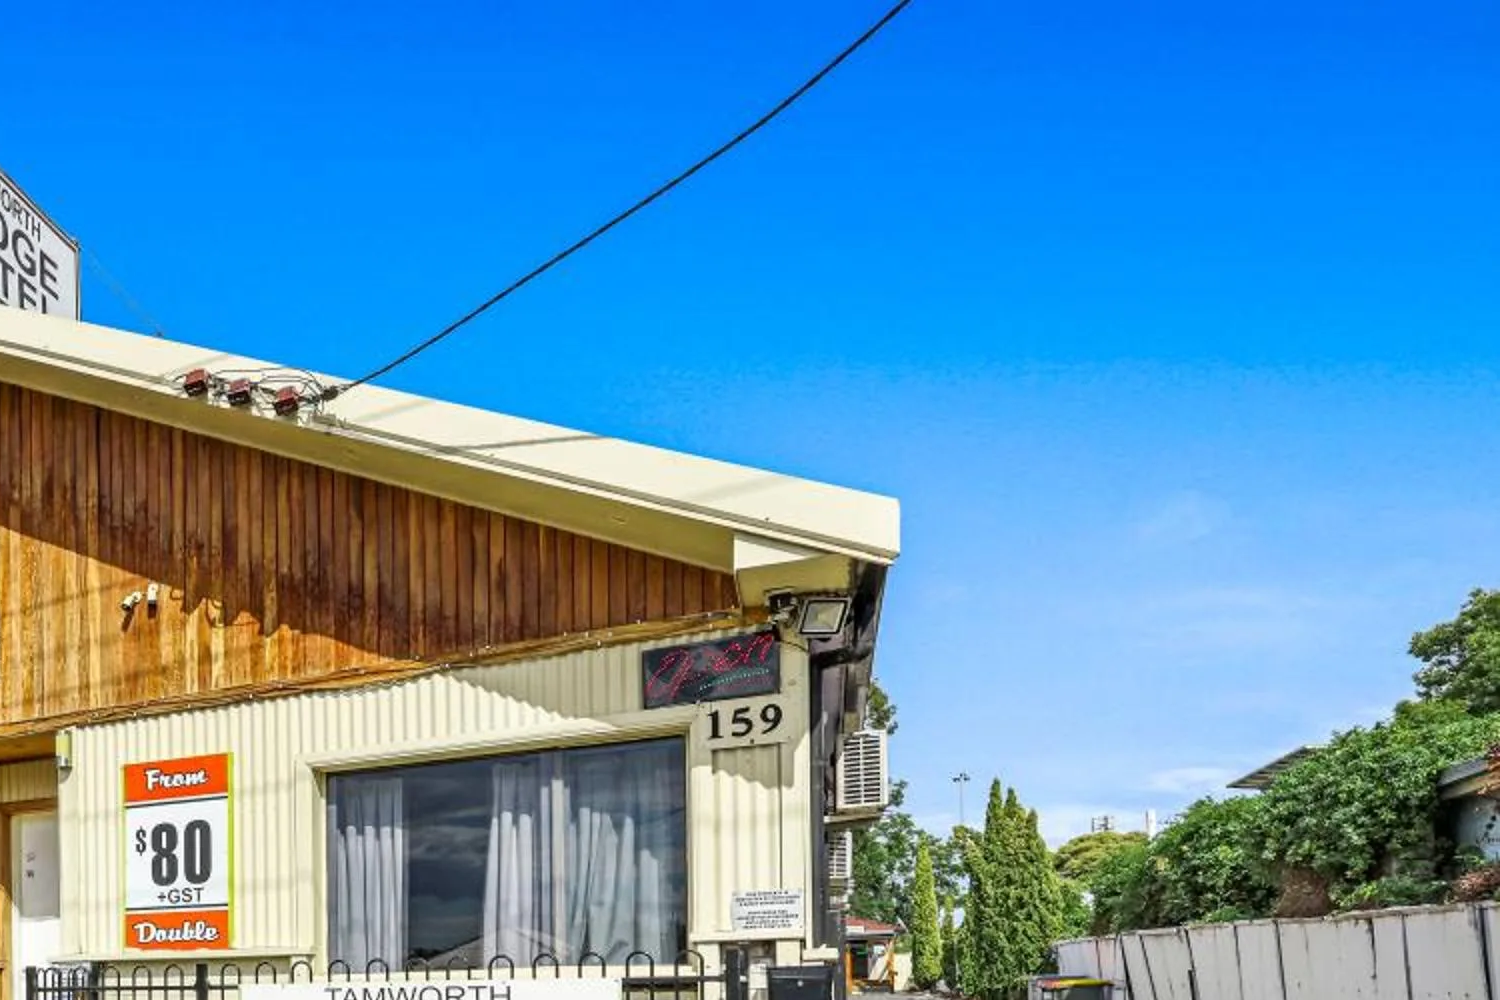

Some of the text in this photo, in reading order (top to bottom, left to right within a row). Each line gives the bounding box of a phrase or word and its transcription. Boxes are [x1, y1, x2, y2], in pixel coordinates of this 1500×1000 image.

[707, 703, 782, 740] 159
[144, 767, 208, 791] From
[135, 819, 212, 886] $80
[157, 887, 204, 904] +GST
[133, 920, 220, 943] Double
